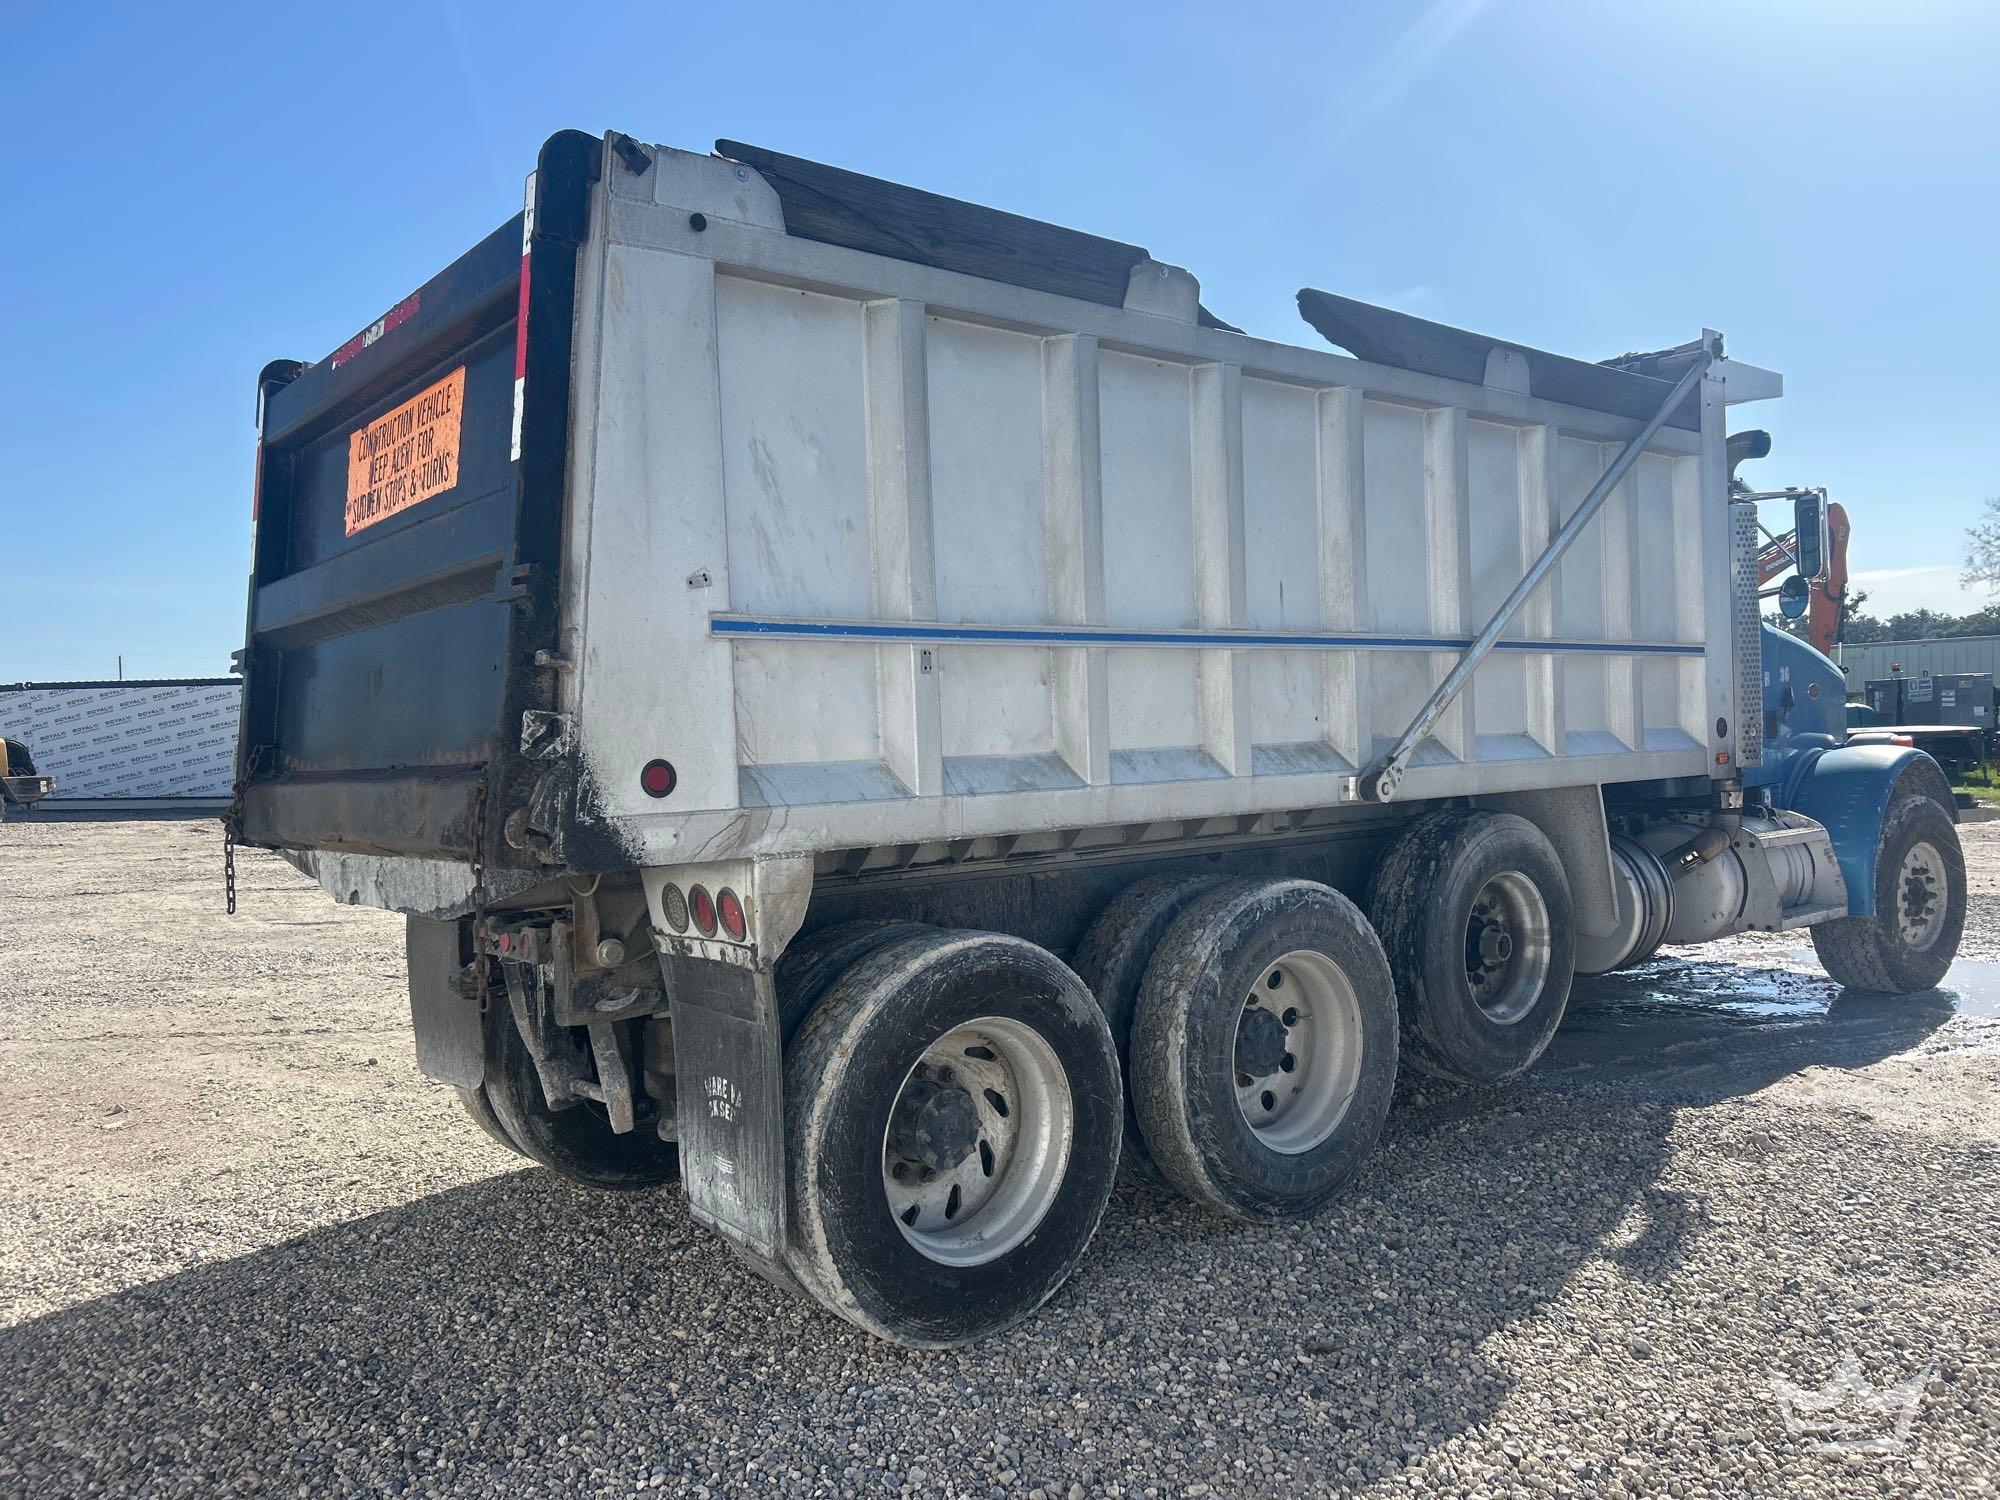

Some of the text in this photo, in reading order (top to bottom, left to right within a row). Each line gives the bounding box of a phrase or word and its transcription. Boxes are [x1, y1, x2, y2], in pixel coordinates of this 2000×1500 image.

[358, 383, 452, 462] CONSTRUCTION VEHICLE
[390, 437, 415, 476] ALERT
[417, 427, 434, 461] FOR
[352, 452, 451, 525] SUDDEN STOPS & TURNS
[1765, 552, 1794, 572] DOOSA
[1779, 666, 1790, 683] 36
[99, 689, 121, 697] ROYAL
[153, 691, 174, 699] ROYAL
[205, 693, 227, 701] ROYAL
[66, 697, 88, 705] ROYAL
[120, 699, 141, 707] ROYAL
[171, 701, 193, 709] ROYAL
[34, 705, 56, 713] ROYAL
[87, 707, 108, 715] ROYAL
[138, 709, 160, 717] ROYAL
[54, 715, 76, 723] ROYAL
[192, 711, 214, 719] ROYAL
[105, 717, 127, 725] ROYAL
[158, 719, 180, 727] ROYAL
[211, 721, 232, 729] ROYAL
[72, 725, 94, 733] ROYAL
[125, 727, 147, 735] ROYAL
[177, 729, 199, 737] ROYAL
[40, 733, 61, 741] ROYAL
[92, 735, 114, 743] ROYAL
[144, 737, 165, 745] ROYAL
[60, 742, 81, 750] ROYAL
[198, 739, 219, 747] ROYAL
[111, 745, 132, 753] ROYAL
[164, 746, 186, 754] ROYAL
[78, 752, 99, 760] ROYAL
[131, 754, 153, 762] ROYAL
[45, 760, 67, 768] ROYAL
[183, 757, 204, 765] ROYAL
[98, 762, 120, 770] ROYAL
[149, 764, 171, 772] ROYAL
[65, 770, 87, 778] ROYAL
[204, 767, 225, 775] ROYAL
[116, 772, 138, 780] ROYAL
[136, 782, 158, 790] ROYAL
[188, 785, 210, 793] ROYAL
